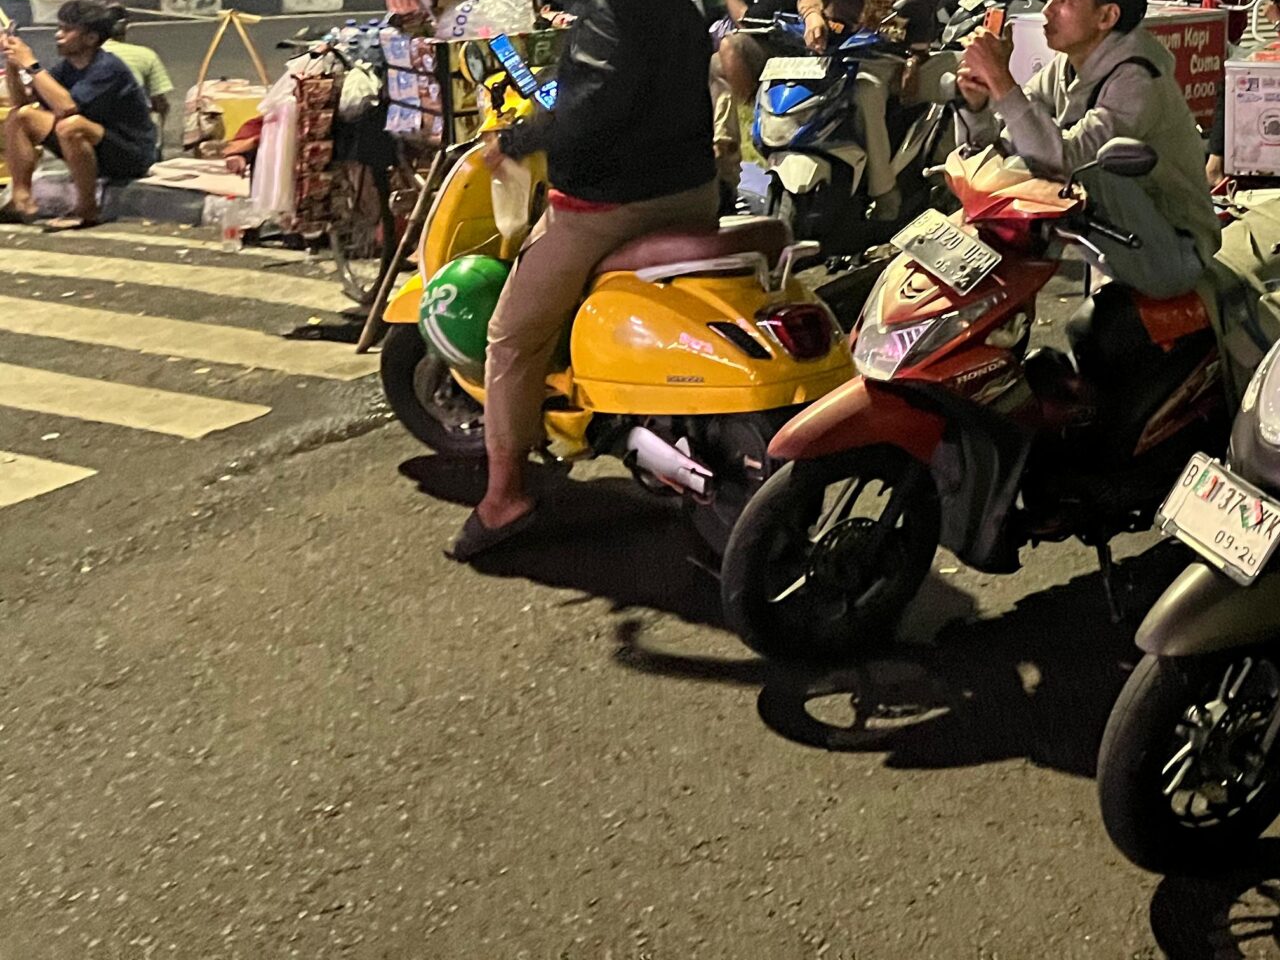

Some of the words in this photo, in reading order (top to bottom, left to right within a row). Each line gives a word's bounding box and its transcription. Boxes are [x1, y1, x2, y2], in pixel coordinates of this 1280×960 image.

[1184, 24, 1210, 52] Kopi
[1190, 54, 1220, 74] Cuma
[957, 359, 1007, 385] HONDA
[1182, 464, 1199, 487] B
[1203, 476, 1245, 515] 137
